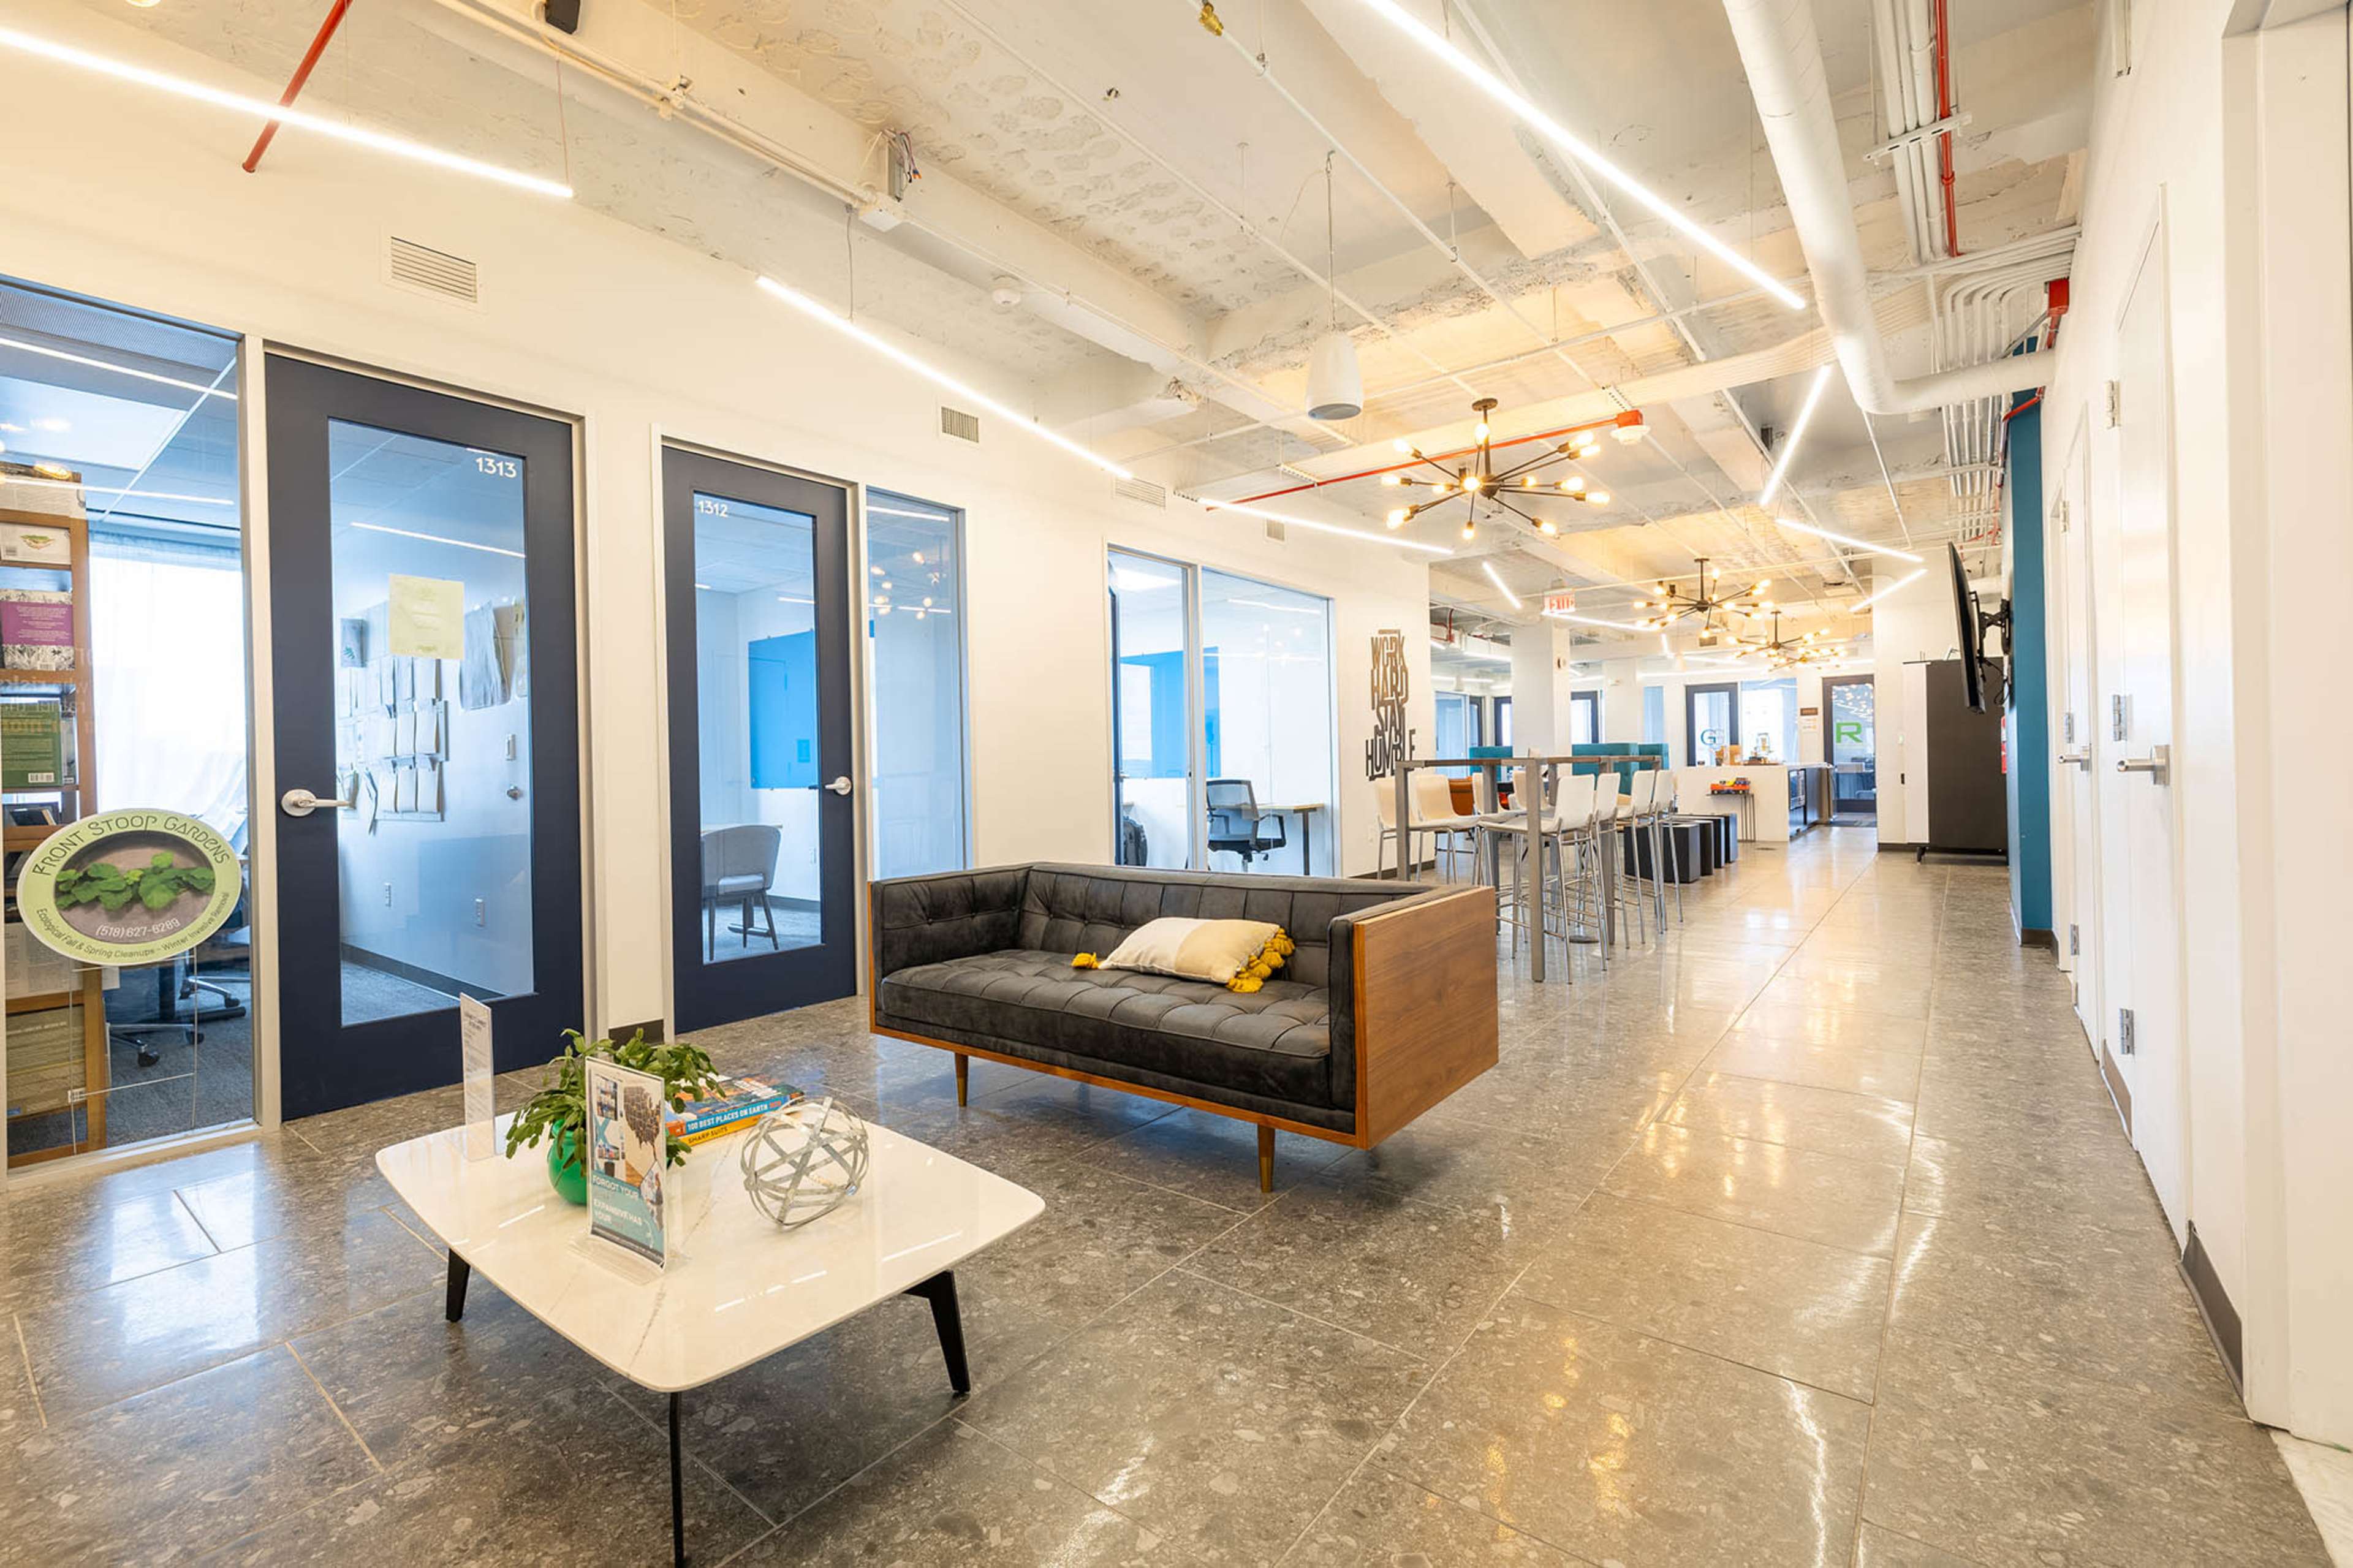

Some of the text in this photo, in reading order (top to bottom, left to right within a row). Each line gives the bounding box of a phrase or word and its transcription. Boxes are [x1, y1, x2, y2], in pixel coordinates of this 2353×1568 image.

[476, 457, 517, 478] 1313
[699, 499, 728, 517] 1312
[1549, 596, 1574, 610] EXIT
[1371, 665, 1409, 710] HARD
[1836, 722, 1863, 743] R
[32, 830, 85, 876] FRONT
[88, 816, 157, 836] STOOP
[36, 907, 66, 939] Ecological
[61, 935, 79, 948] Fall
[76, 942, 85, 950] &
[83, 945, 113, 959] Spring
[114, 949, 154, 958] Cleanups
[161, 935, 189, 951] Winter
[96, 924, 125, 938] (518)
[699, 1117, 715, 1128] BEST
[715, 1111, 740, 1124] PLACES
[740, 1108, 749, 1117] ON
[749, 1104, 768, 1113] EARTH
